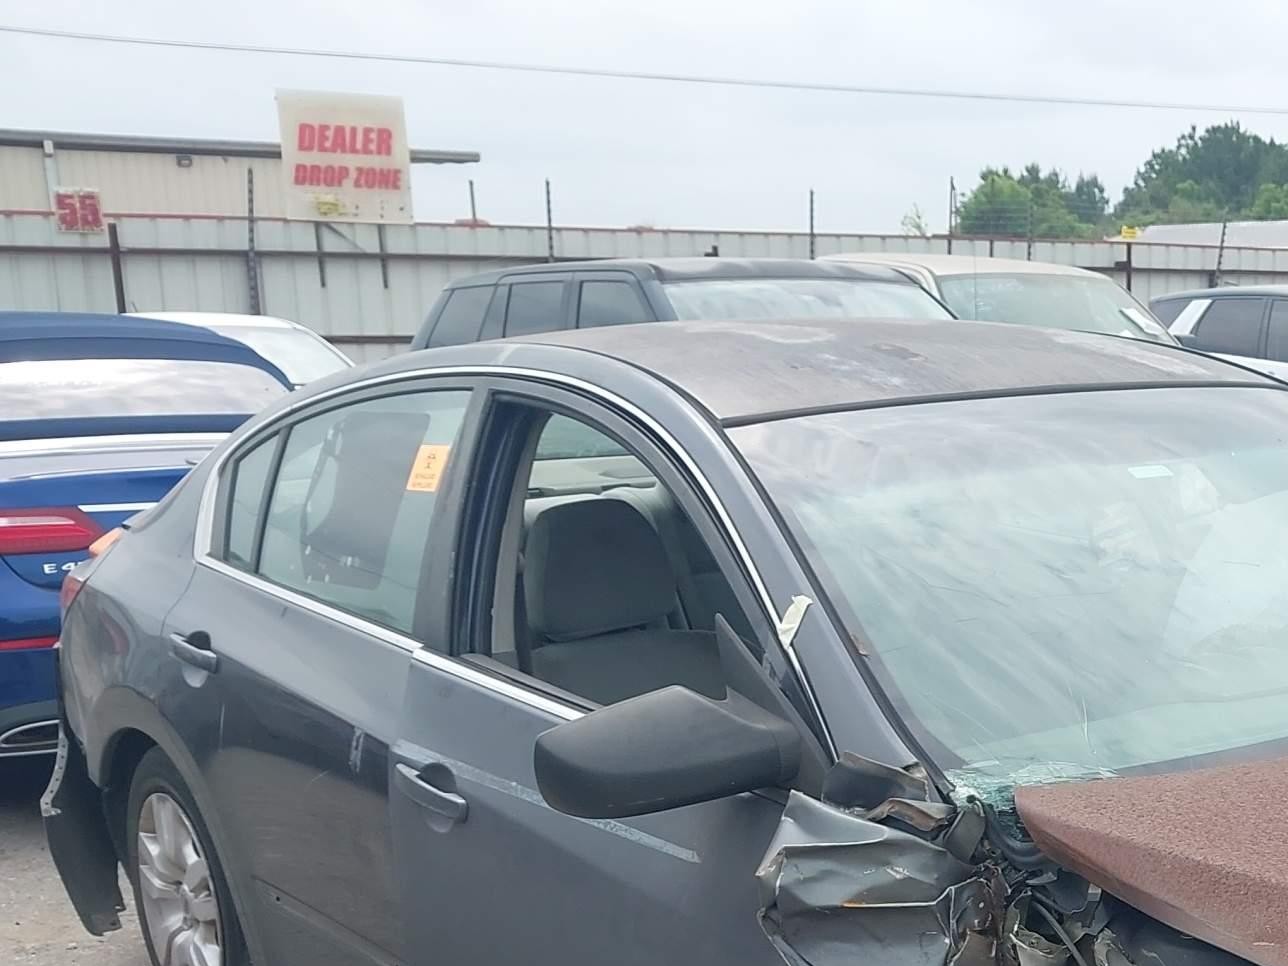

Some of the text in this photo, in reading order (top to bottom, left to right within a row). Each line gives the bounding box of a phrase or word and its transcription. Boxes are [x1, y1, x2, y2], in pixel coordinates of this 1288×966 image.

[297, 123, 392, 156] DEALER
[293, 163, 402, 190] DROP ZONE
